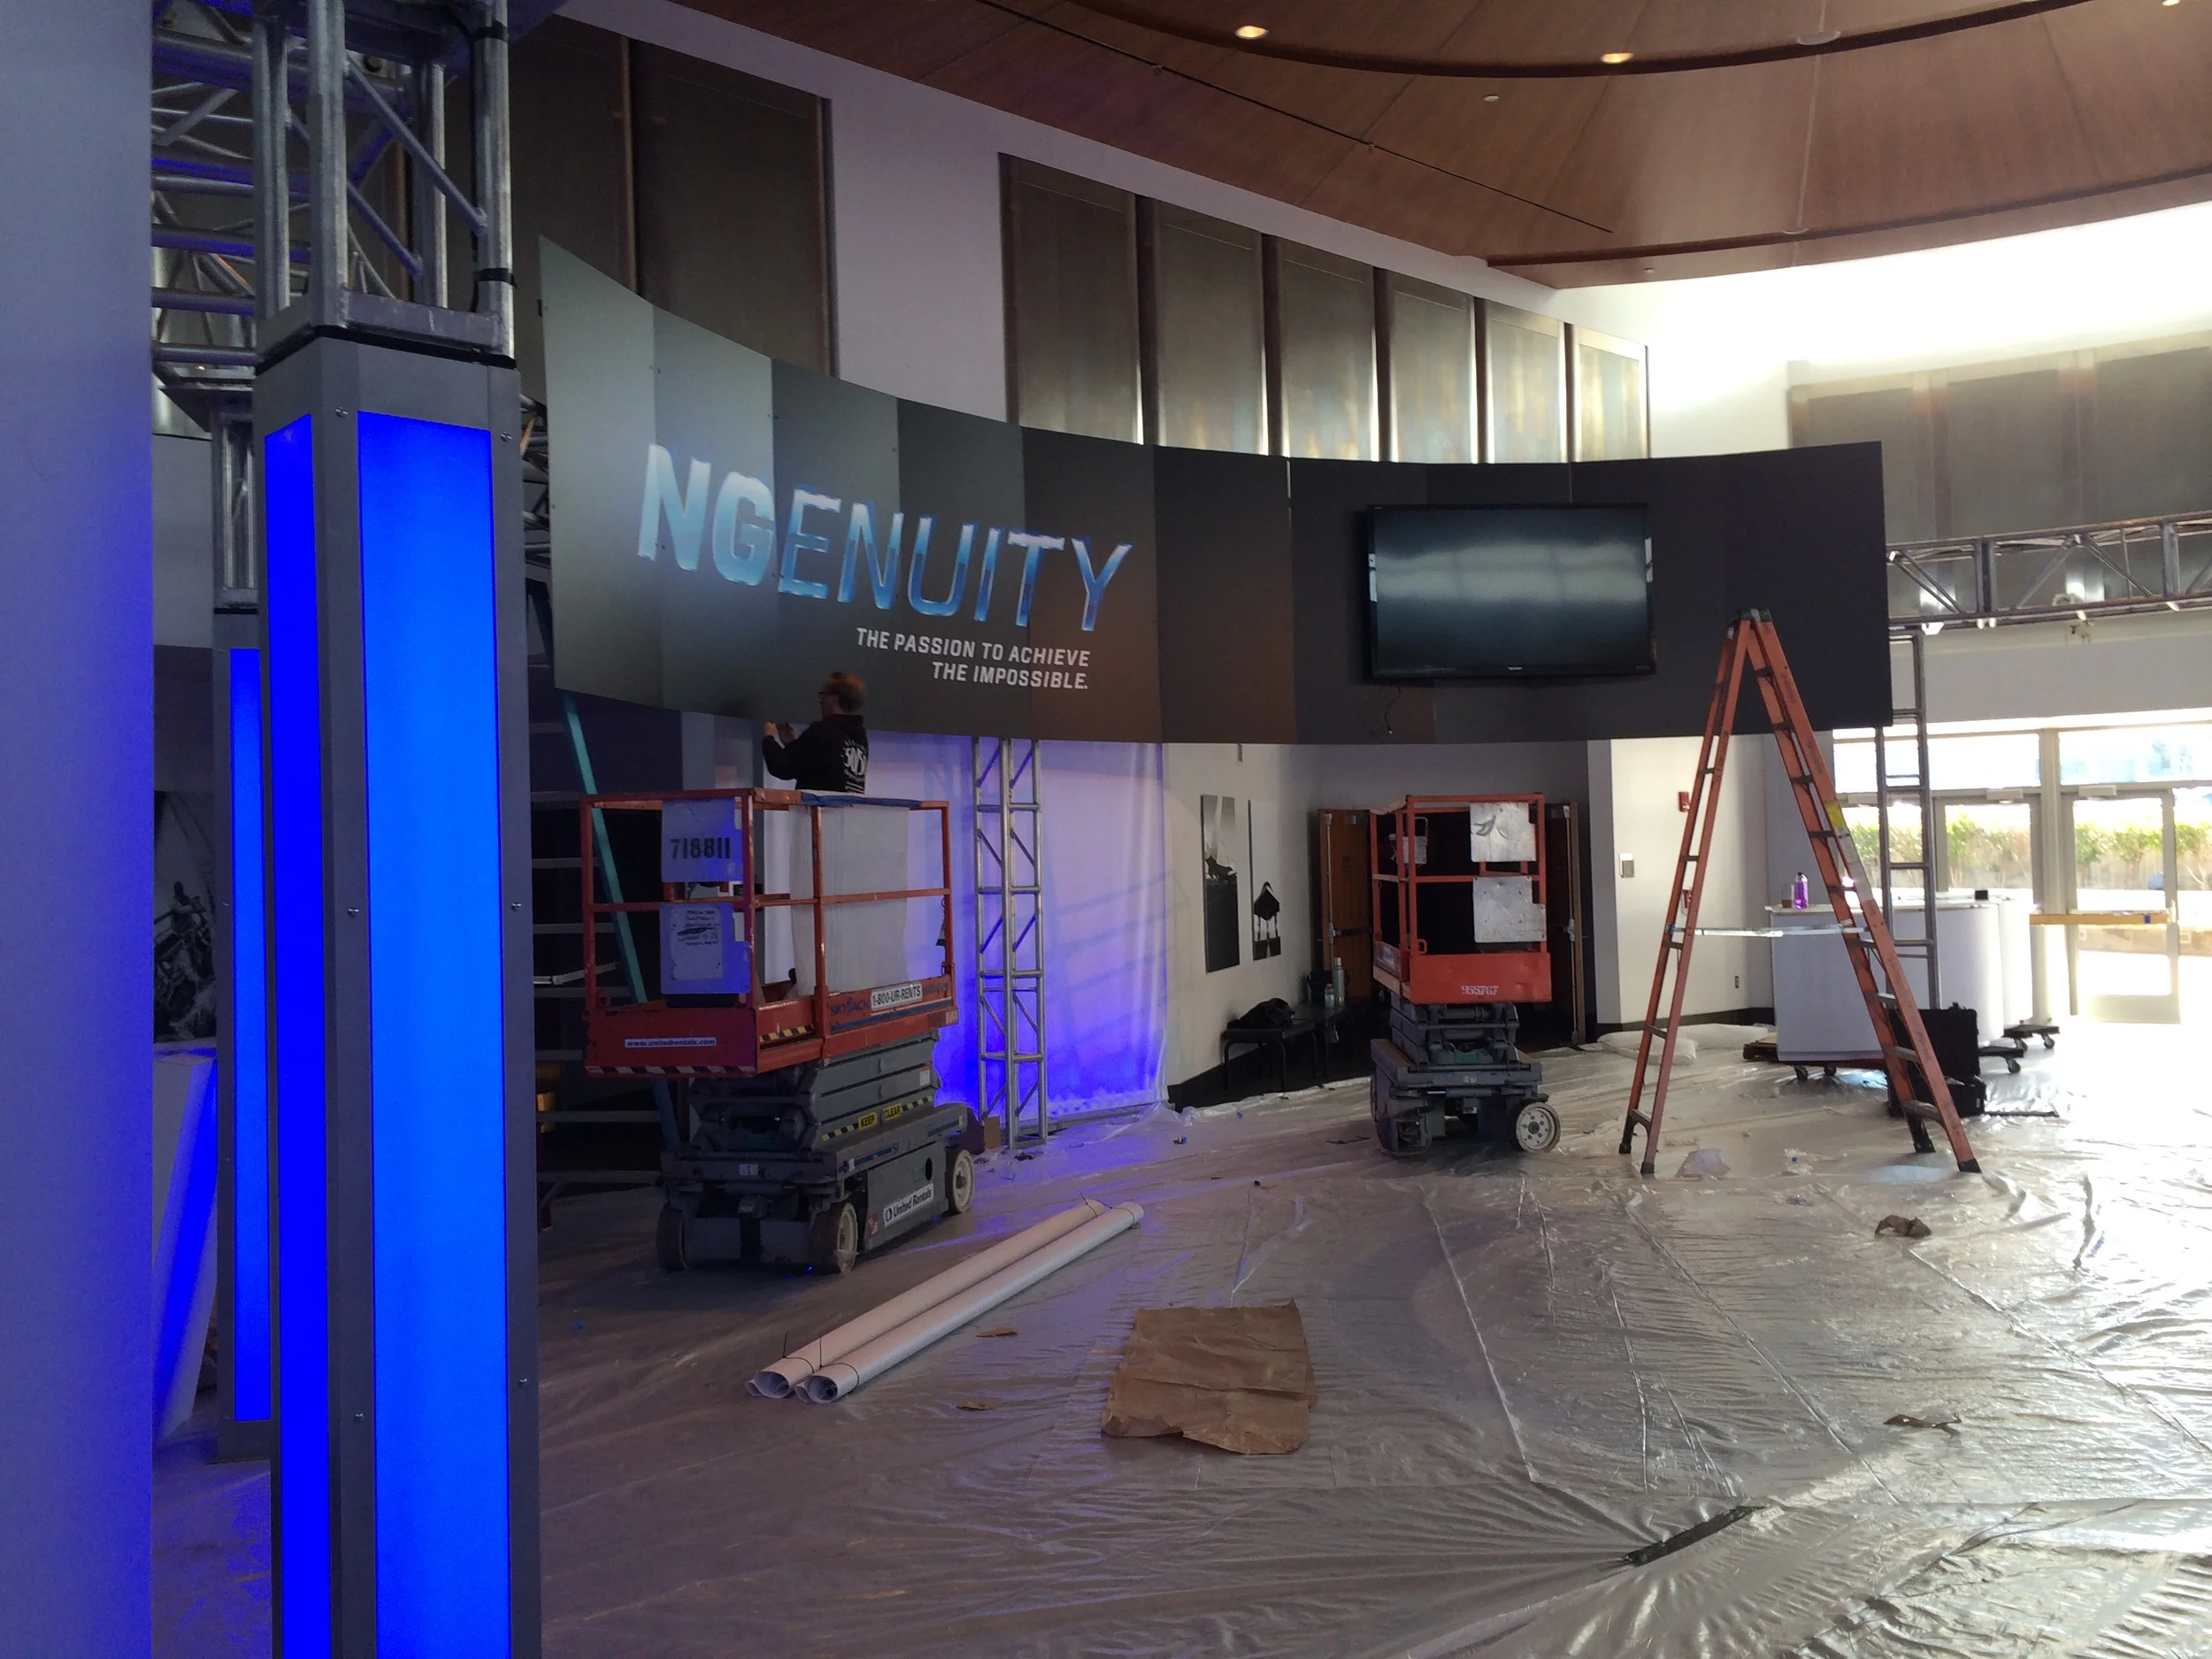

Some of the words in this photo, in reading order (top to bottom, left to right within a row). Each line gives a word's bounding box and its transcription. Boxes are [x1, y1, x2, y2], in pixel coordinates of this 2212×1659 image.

[637, 442, 1135, 632] NGENUITY
[856, 627, 890, 649] THE
[894, 633, 976, 658] PASSION
[982, 642, 1003, 661] TO
[1008, 646, 1090, 667] ACHIEVE
[933, 662, 968, 681] THE
[973, 665, 1088, 689] IMPOSSIBLE.
[670, 837, 731, 859] 718811
[872, 985, 921, 1007] 1-800-UR-RENTS
[860, 1114, 875, 1127] KEEP
[893, 1197, 912, 1217] United
[912, 1187, 932, 1206] Rentals
